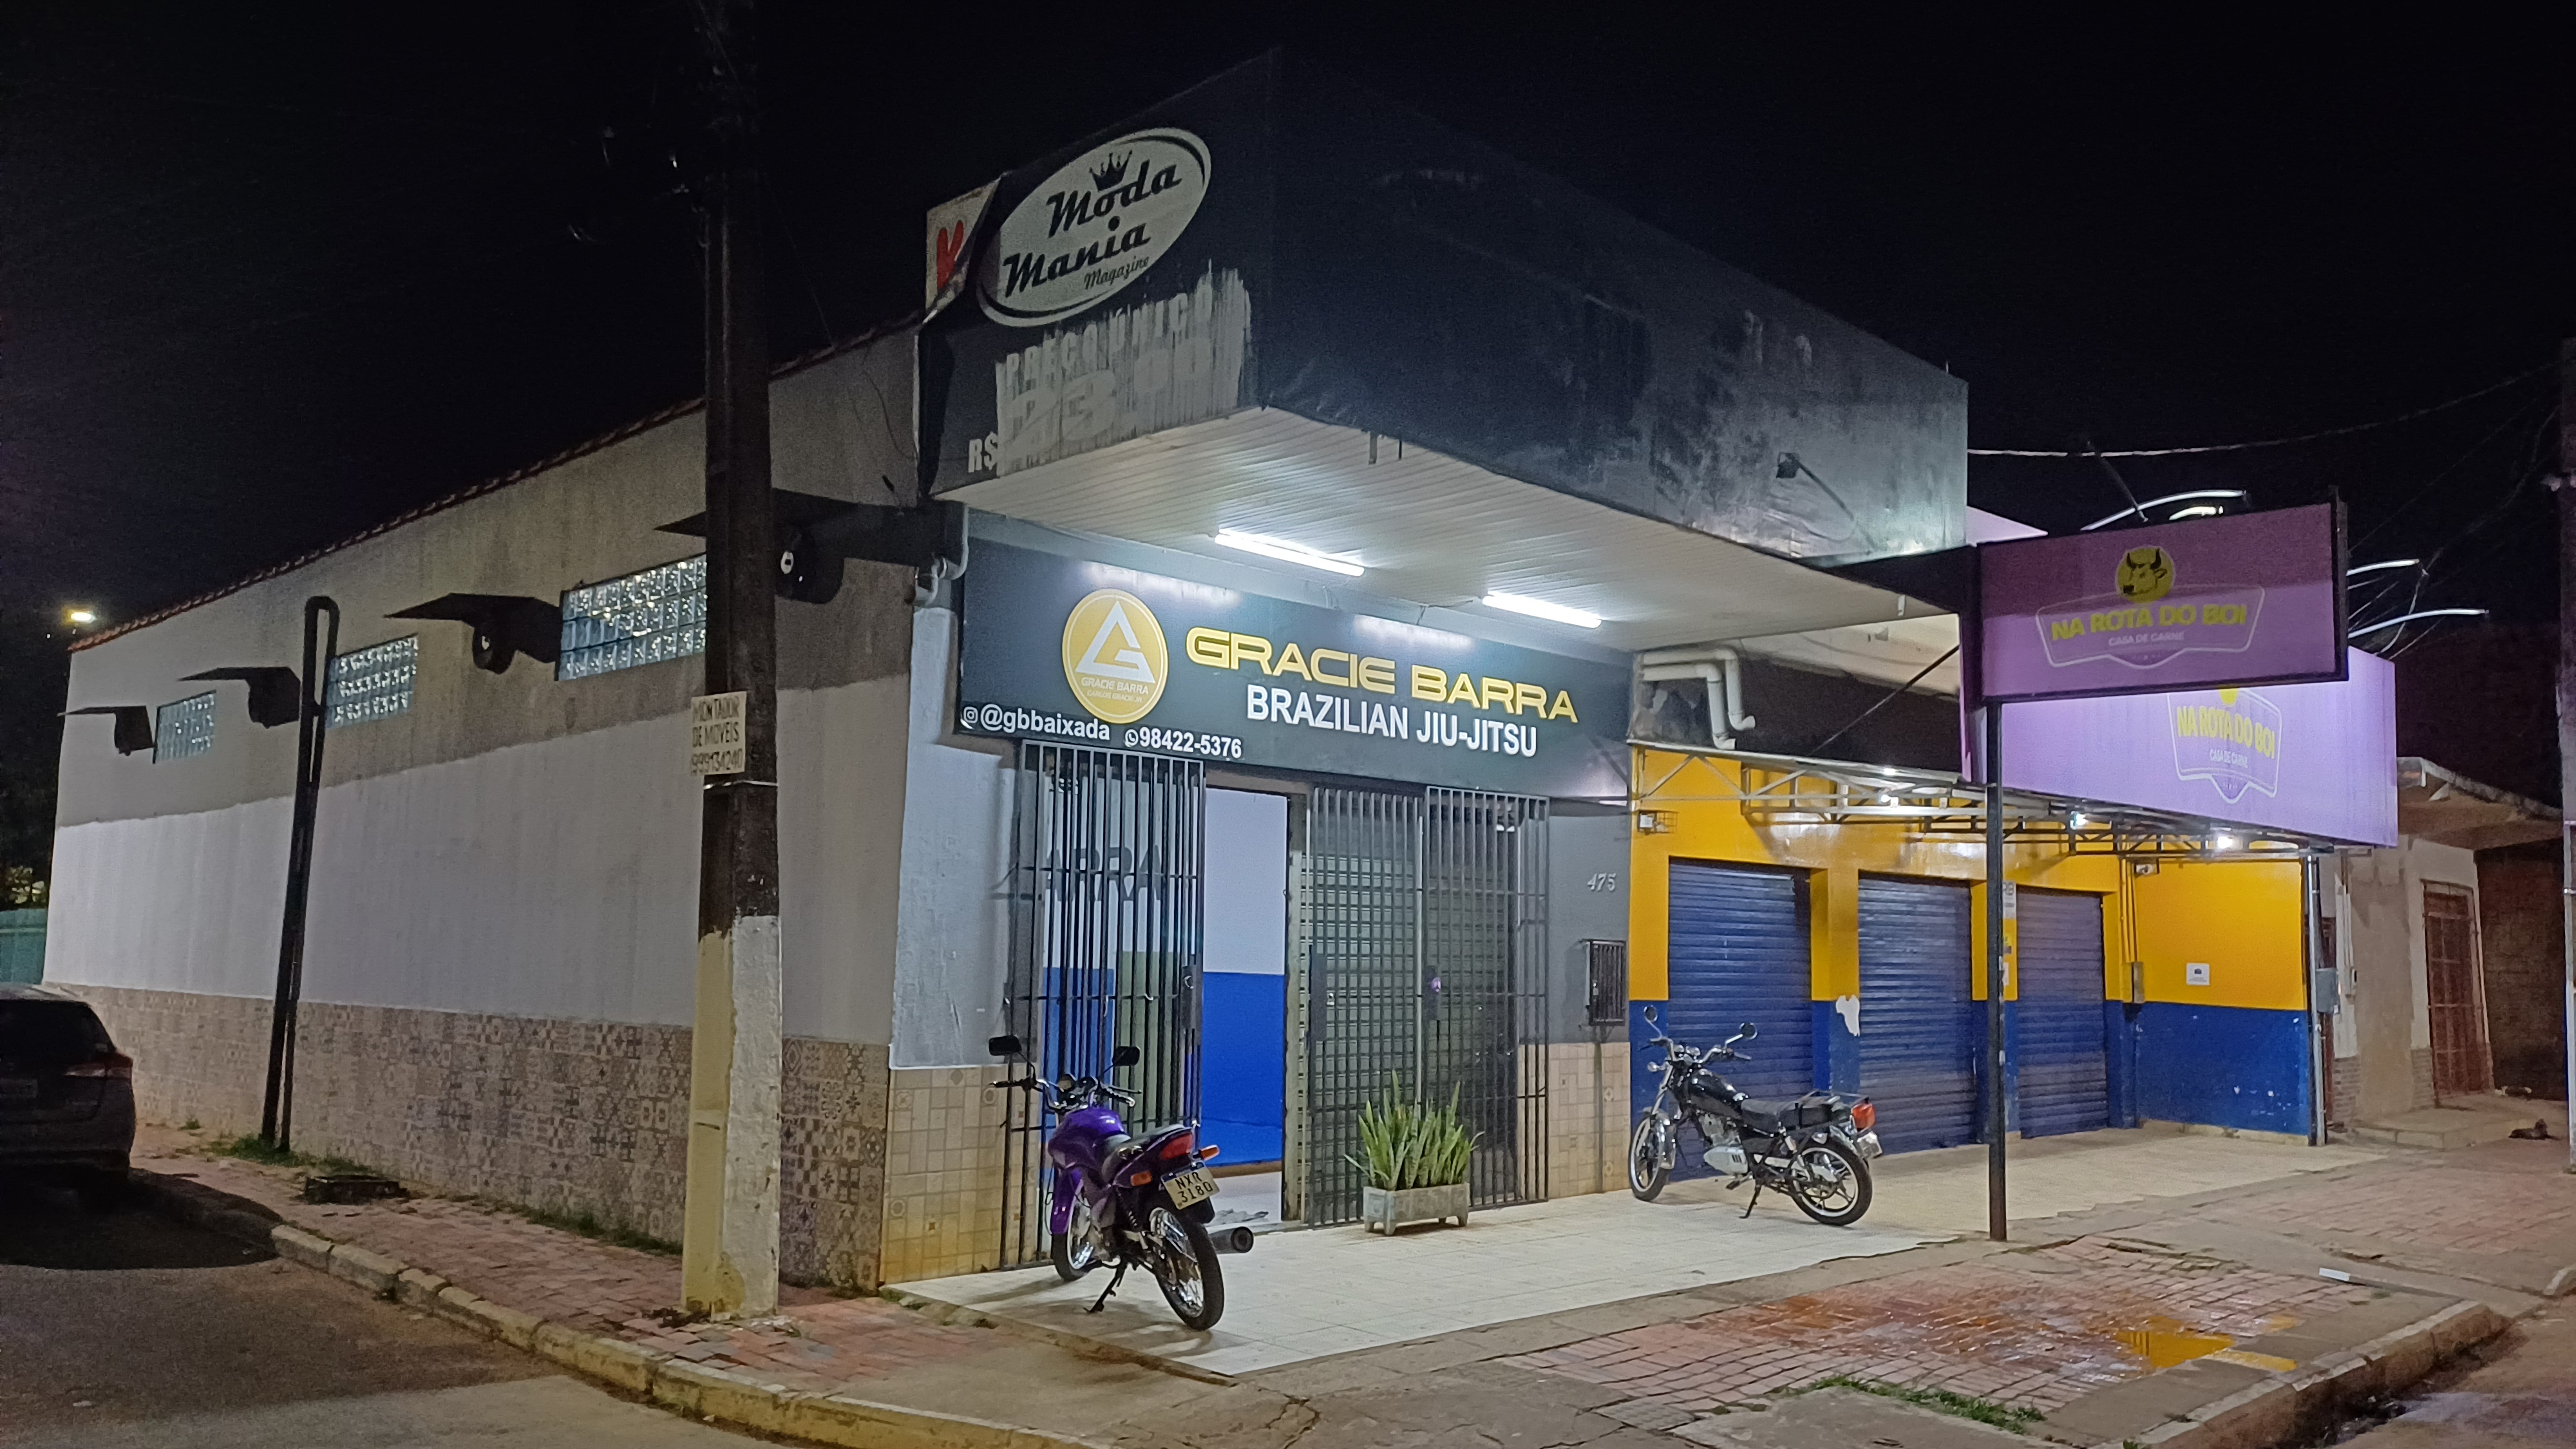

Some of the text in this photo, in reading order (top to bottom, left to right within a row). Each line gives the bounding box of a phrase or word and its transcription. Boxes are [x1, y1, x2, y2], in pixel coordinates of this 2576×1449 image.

[1046, 159, 1182, 239] Moda
[1002, 216, 1151, 299] Mania
[1084, 256, 1150, 290] Magazine
[2051, 603, 2247, 641] NA ROTA DO BOI
[2108, 635, 2135, 647] CASA
[1081, 676, 1149, 695] GRACIE BARRA
[1186, 627, 1578, 723] GRACIE BARRA
[980, 703, 1242, 759] @gbbaixada 98422-5376
[1247, 684, 1537, 757] BRAZILIAN JIU-JITSU
[2177, 705, 2275, 759] NA ROTA DO BOI
[1587, 872, 1616, 892] 475
[1175, 1171, 1202, 1190] NXR
